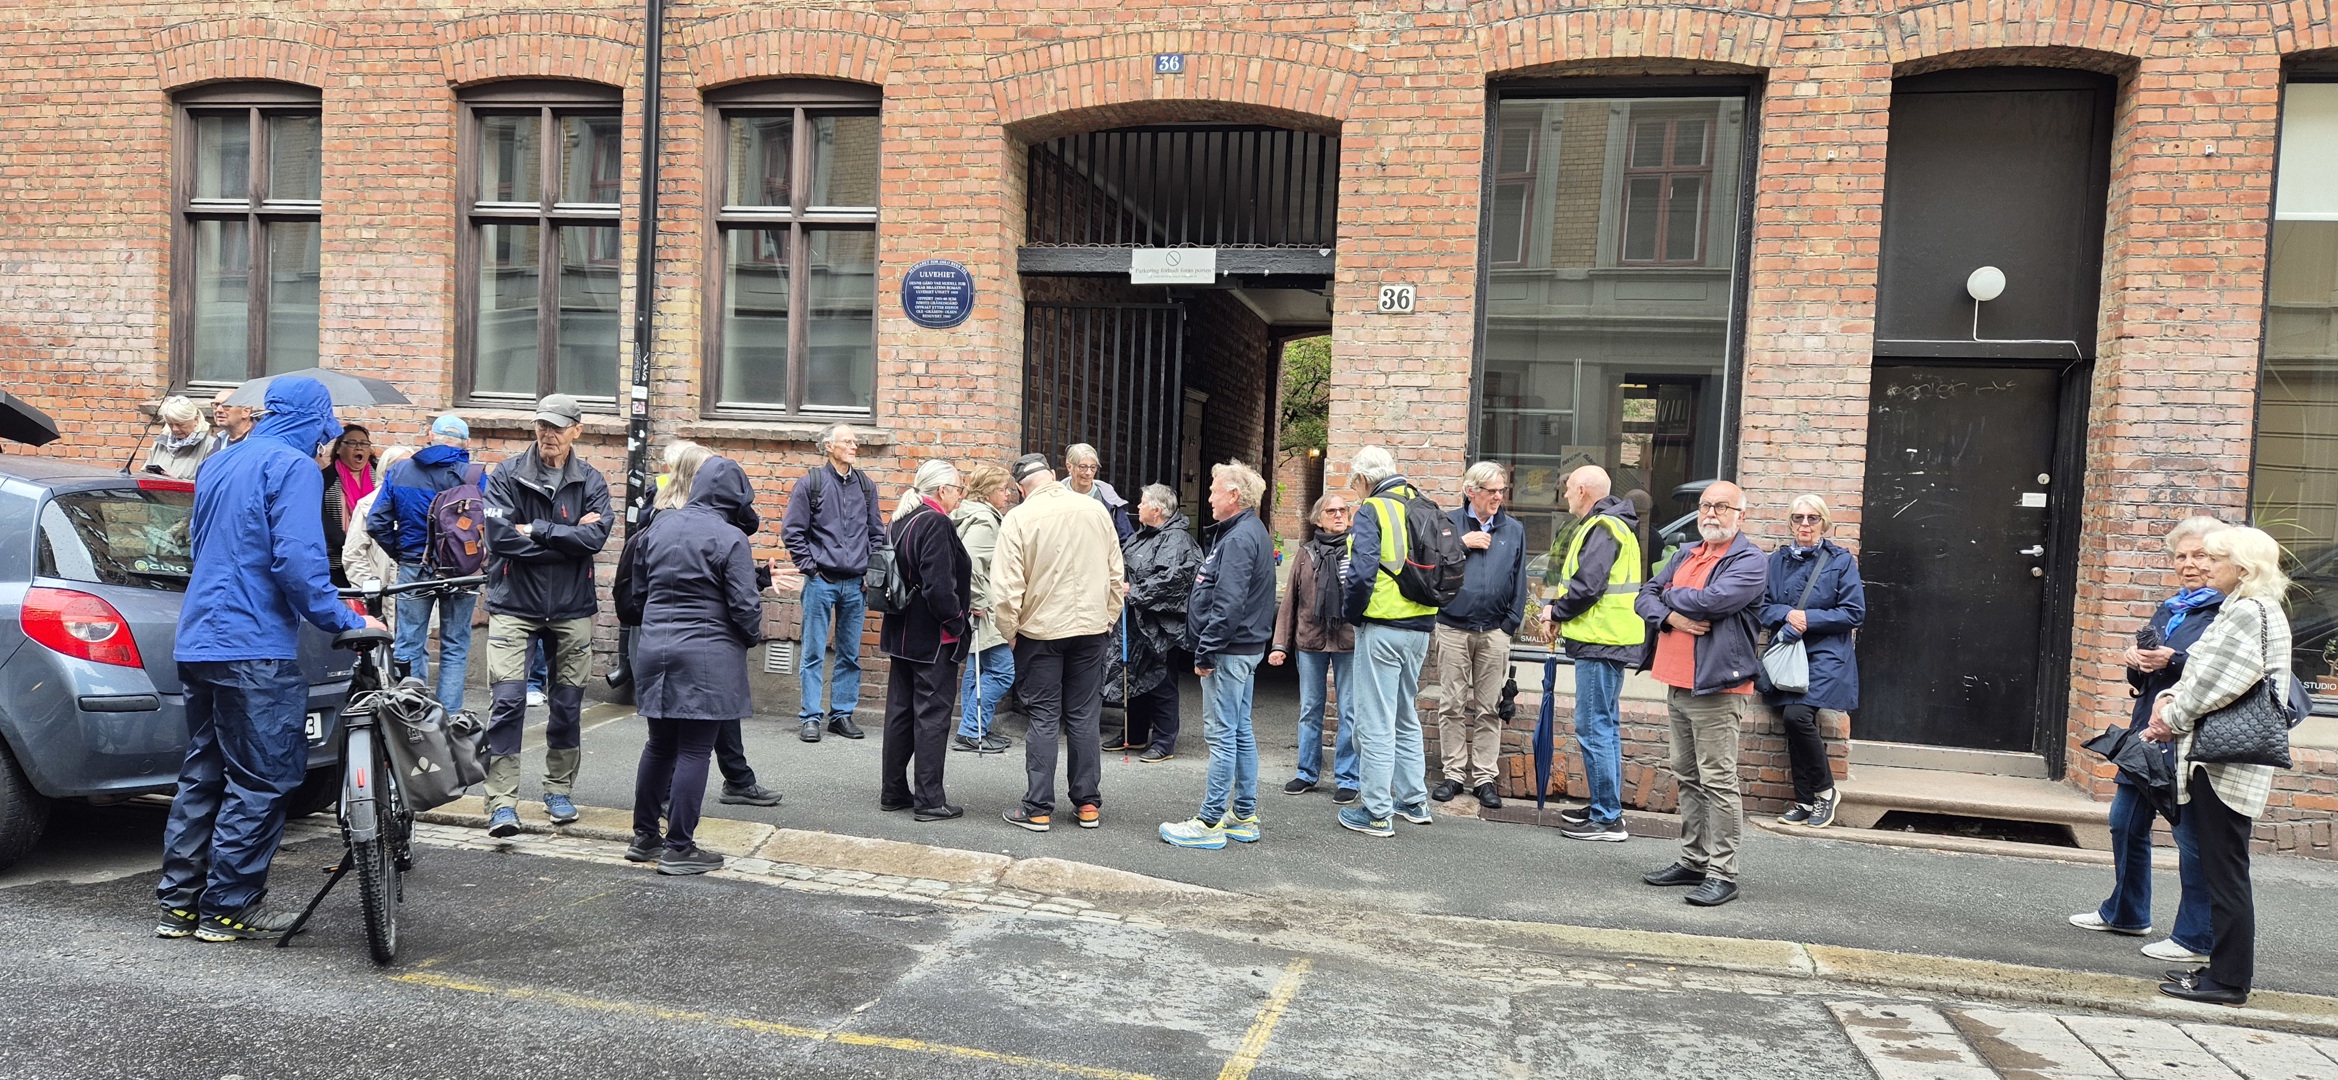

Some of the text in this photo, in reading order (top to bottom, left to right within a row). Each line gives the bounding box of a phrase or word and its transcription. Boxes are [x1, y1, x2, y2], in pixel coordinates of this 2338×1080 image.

[1159, 55, 1180, 71] 36
[1382, 288, 1410, 310] 36
[483, 507, 503, 518] HH
[149, 563, 187, 572] CLIO
[2303, 681, 2337, 691] STUDIO
